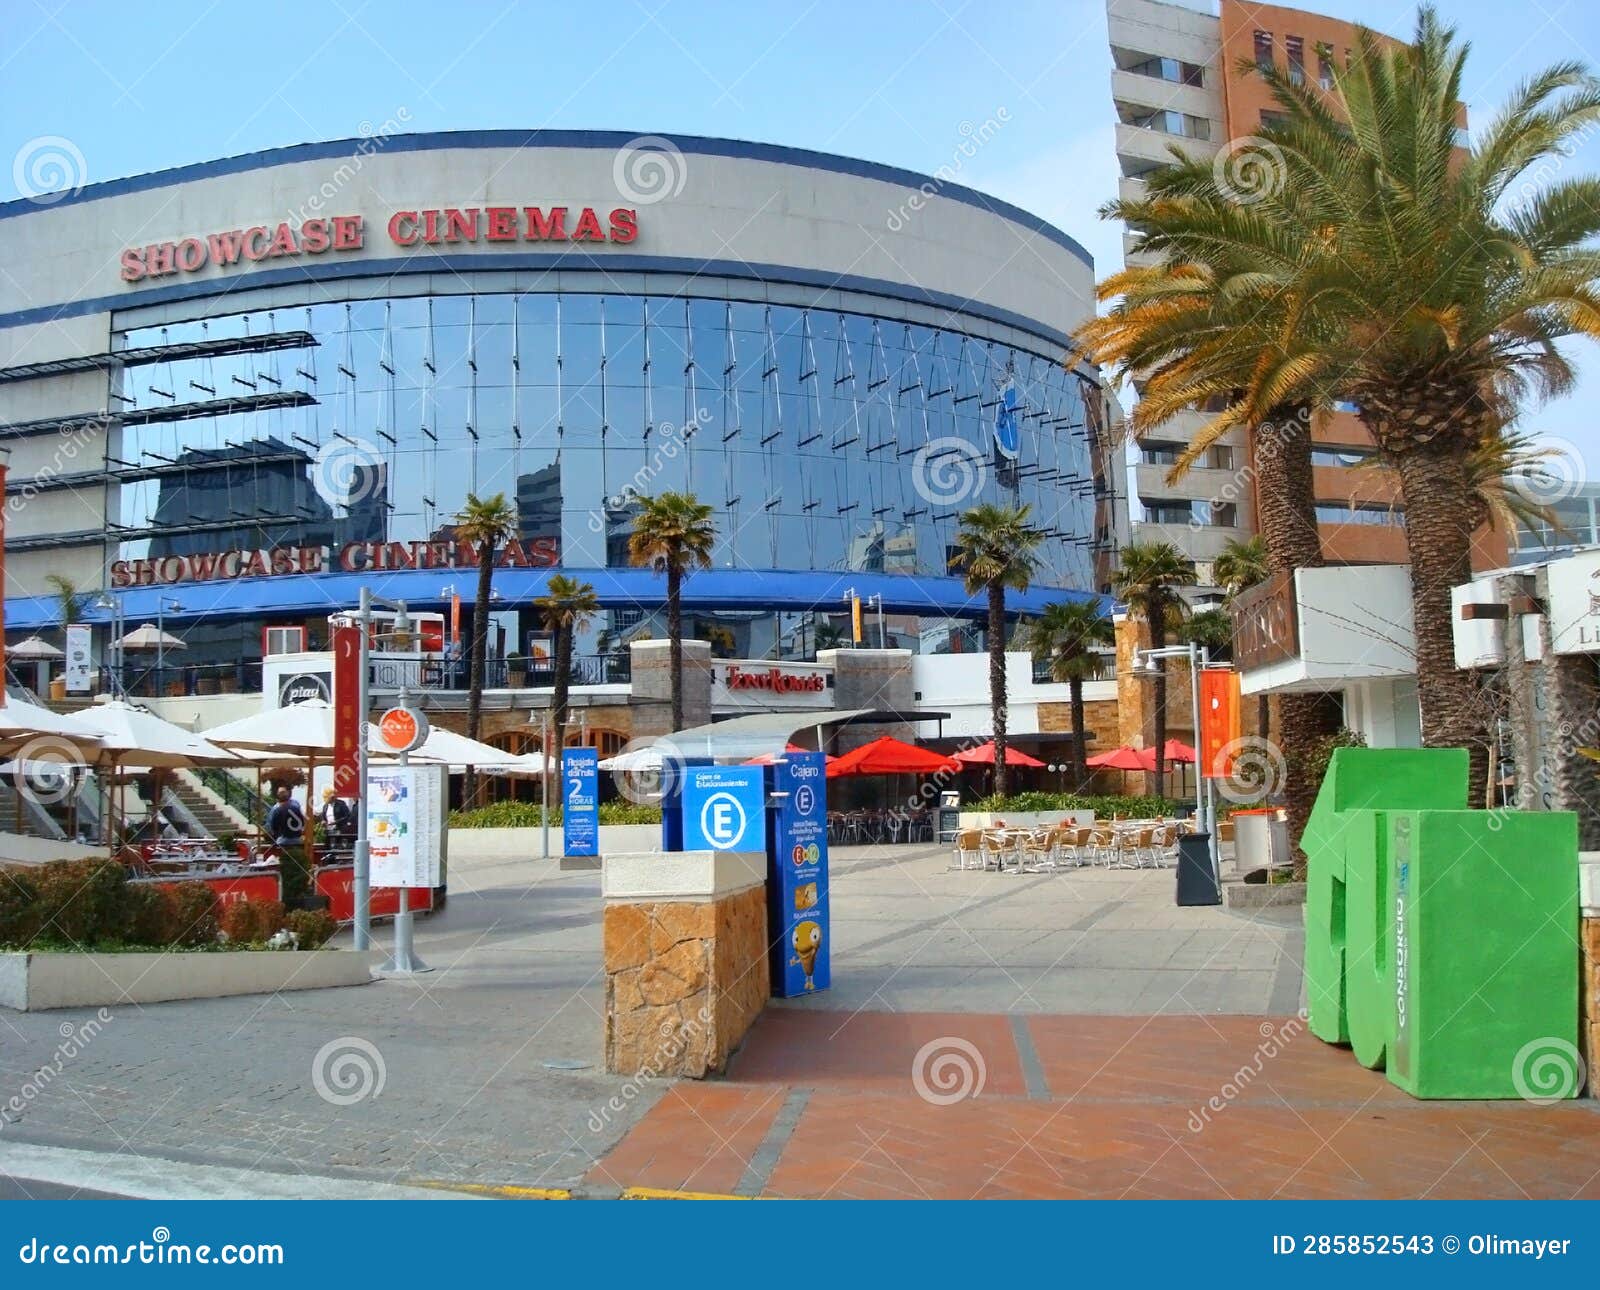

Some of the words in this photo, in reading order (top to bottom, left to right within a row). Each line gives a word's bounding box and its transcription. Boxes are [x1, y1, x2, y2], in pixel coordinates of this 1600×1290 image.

[119, 215, 364, 282] SHOWCASE
[387, 206, 639, 246] CINEMAS
[111, 545, 329, 588] SHOWCASE
[569, 778, 582, 799] 2
[790, 764, 819, 780] Cajero
[800, 791, 810, 809] E
[713, 803, 732, 838] E
[1396, 898, 1405, 1027] CONSORCIO
